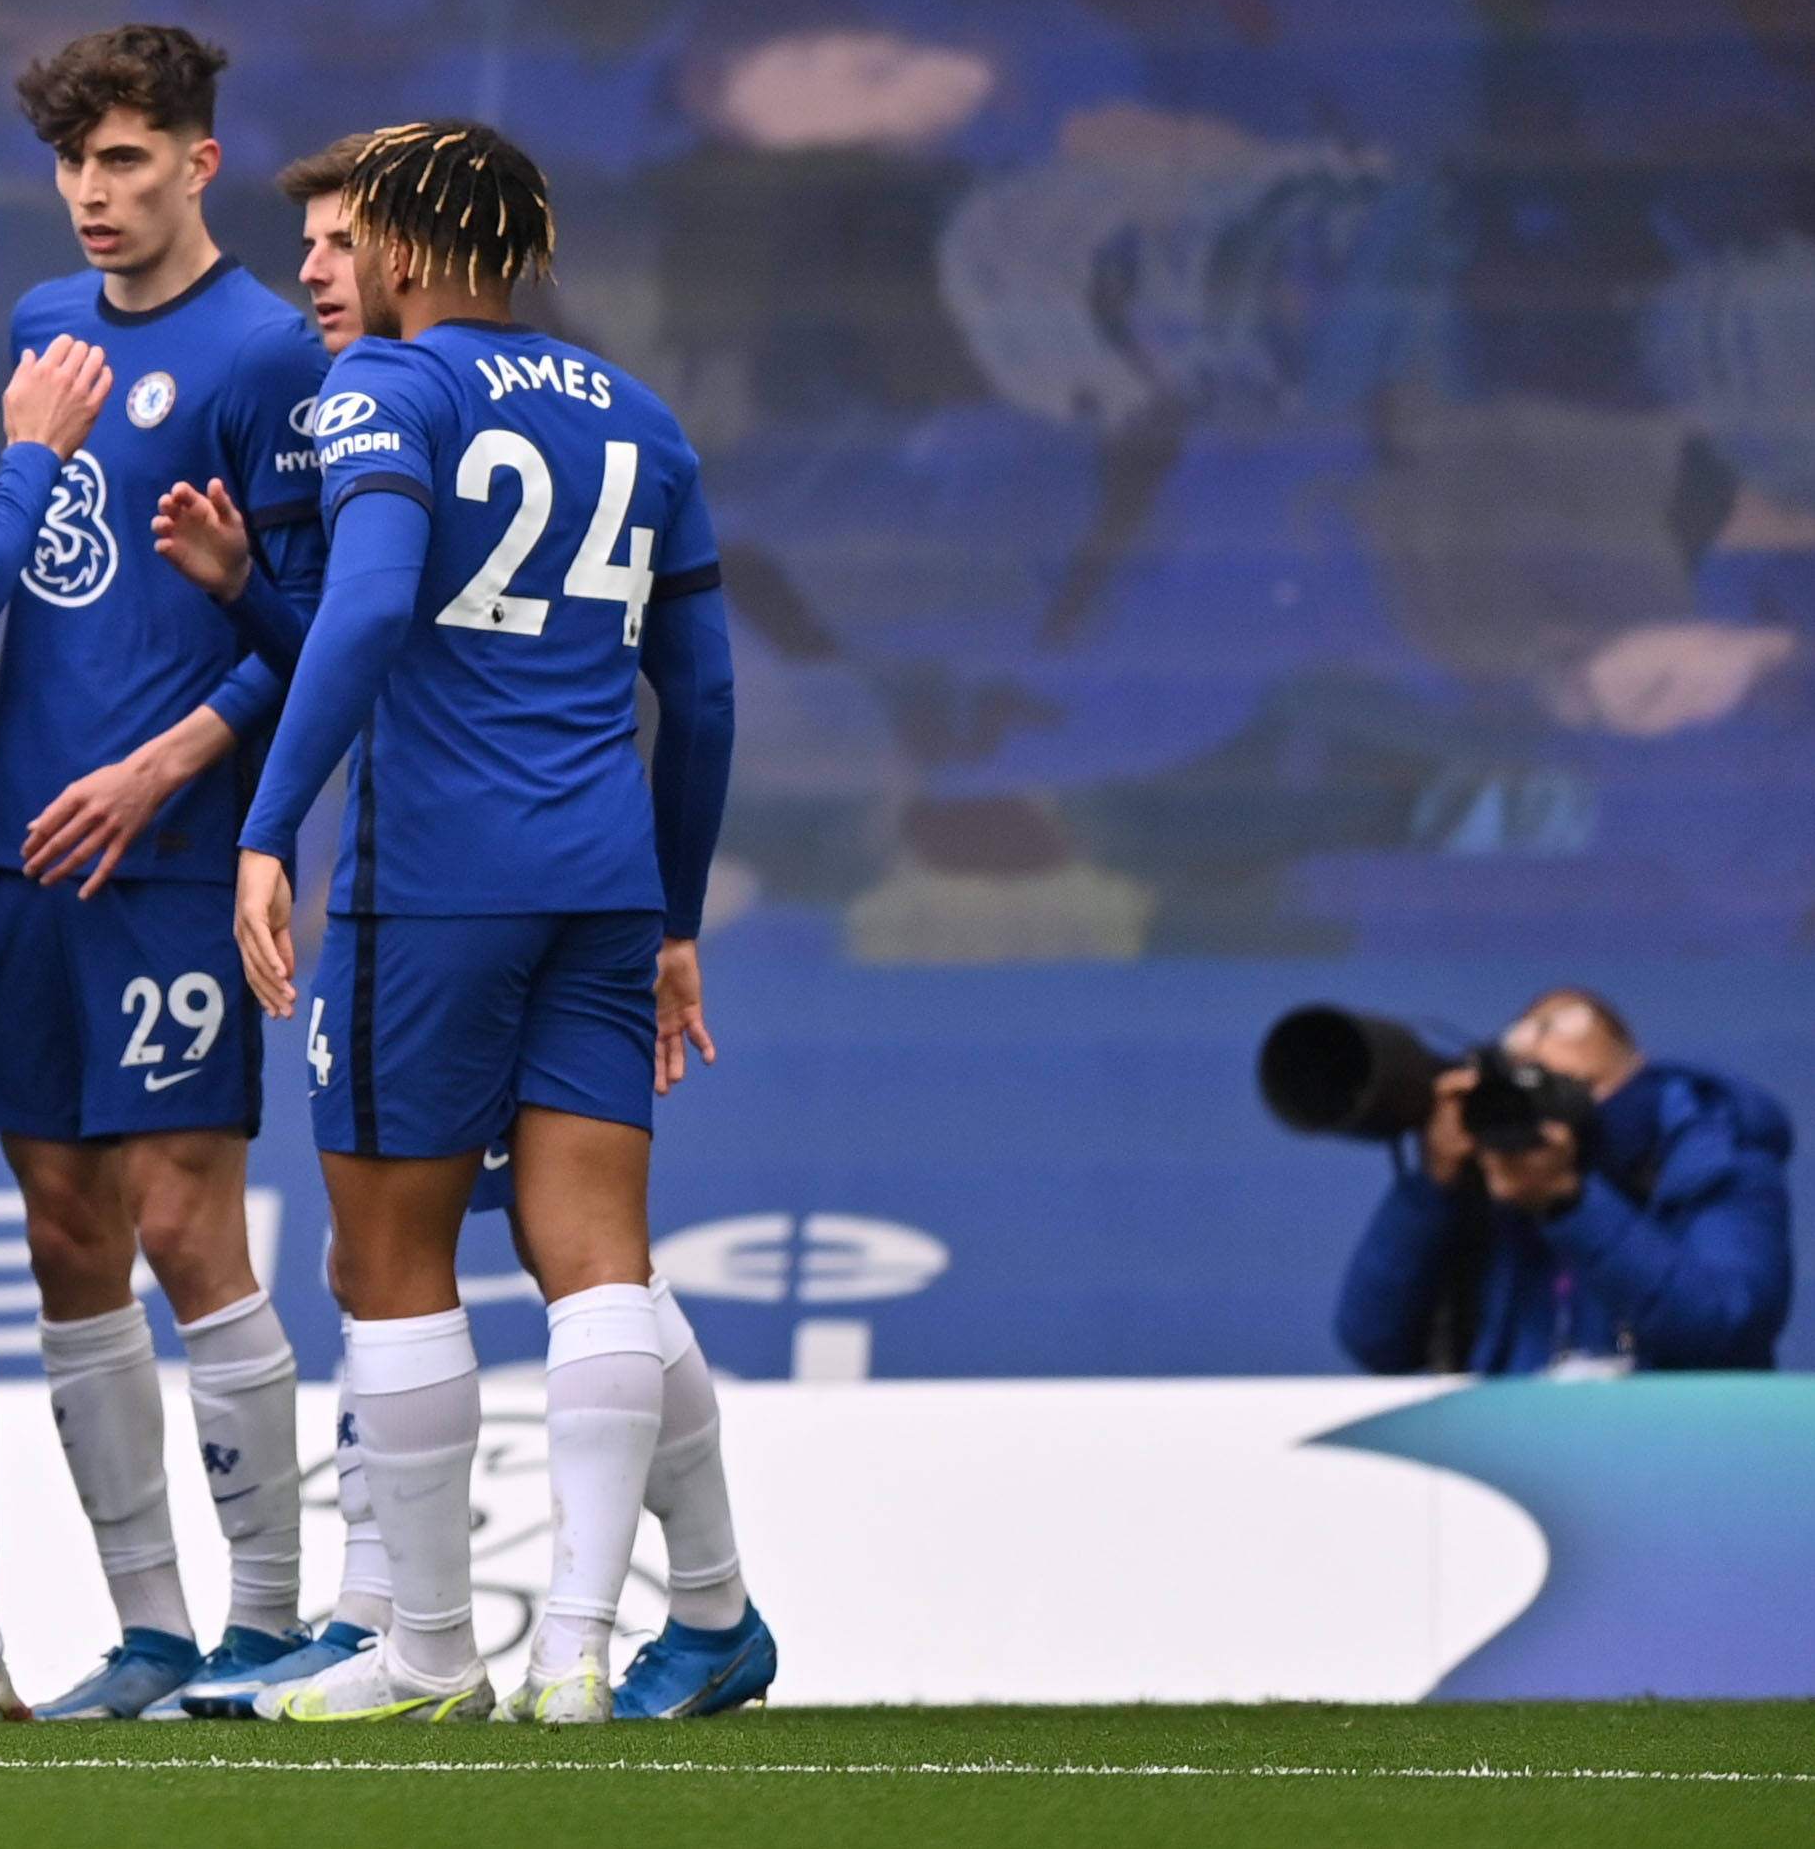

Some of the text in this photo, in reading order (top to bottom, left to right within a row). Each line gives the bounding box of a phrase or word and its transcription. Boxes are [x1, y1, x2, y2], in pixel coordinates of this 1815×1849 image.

[475, 353, 612, 410] JAMES
[320, 432, 400, 468] UNDAI
[435, 429, 655, 648] 24
[120, 972, 224, 1067] 29
